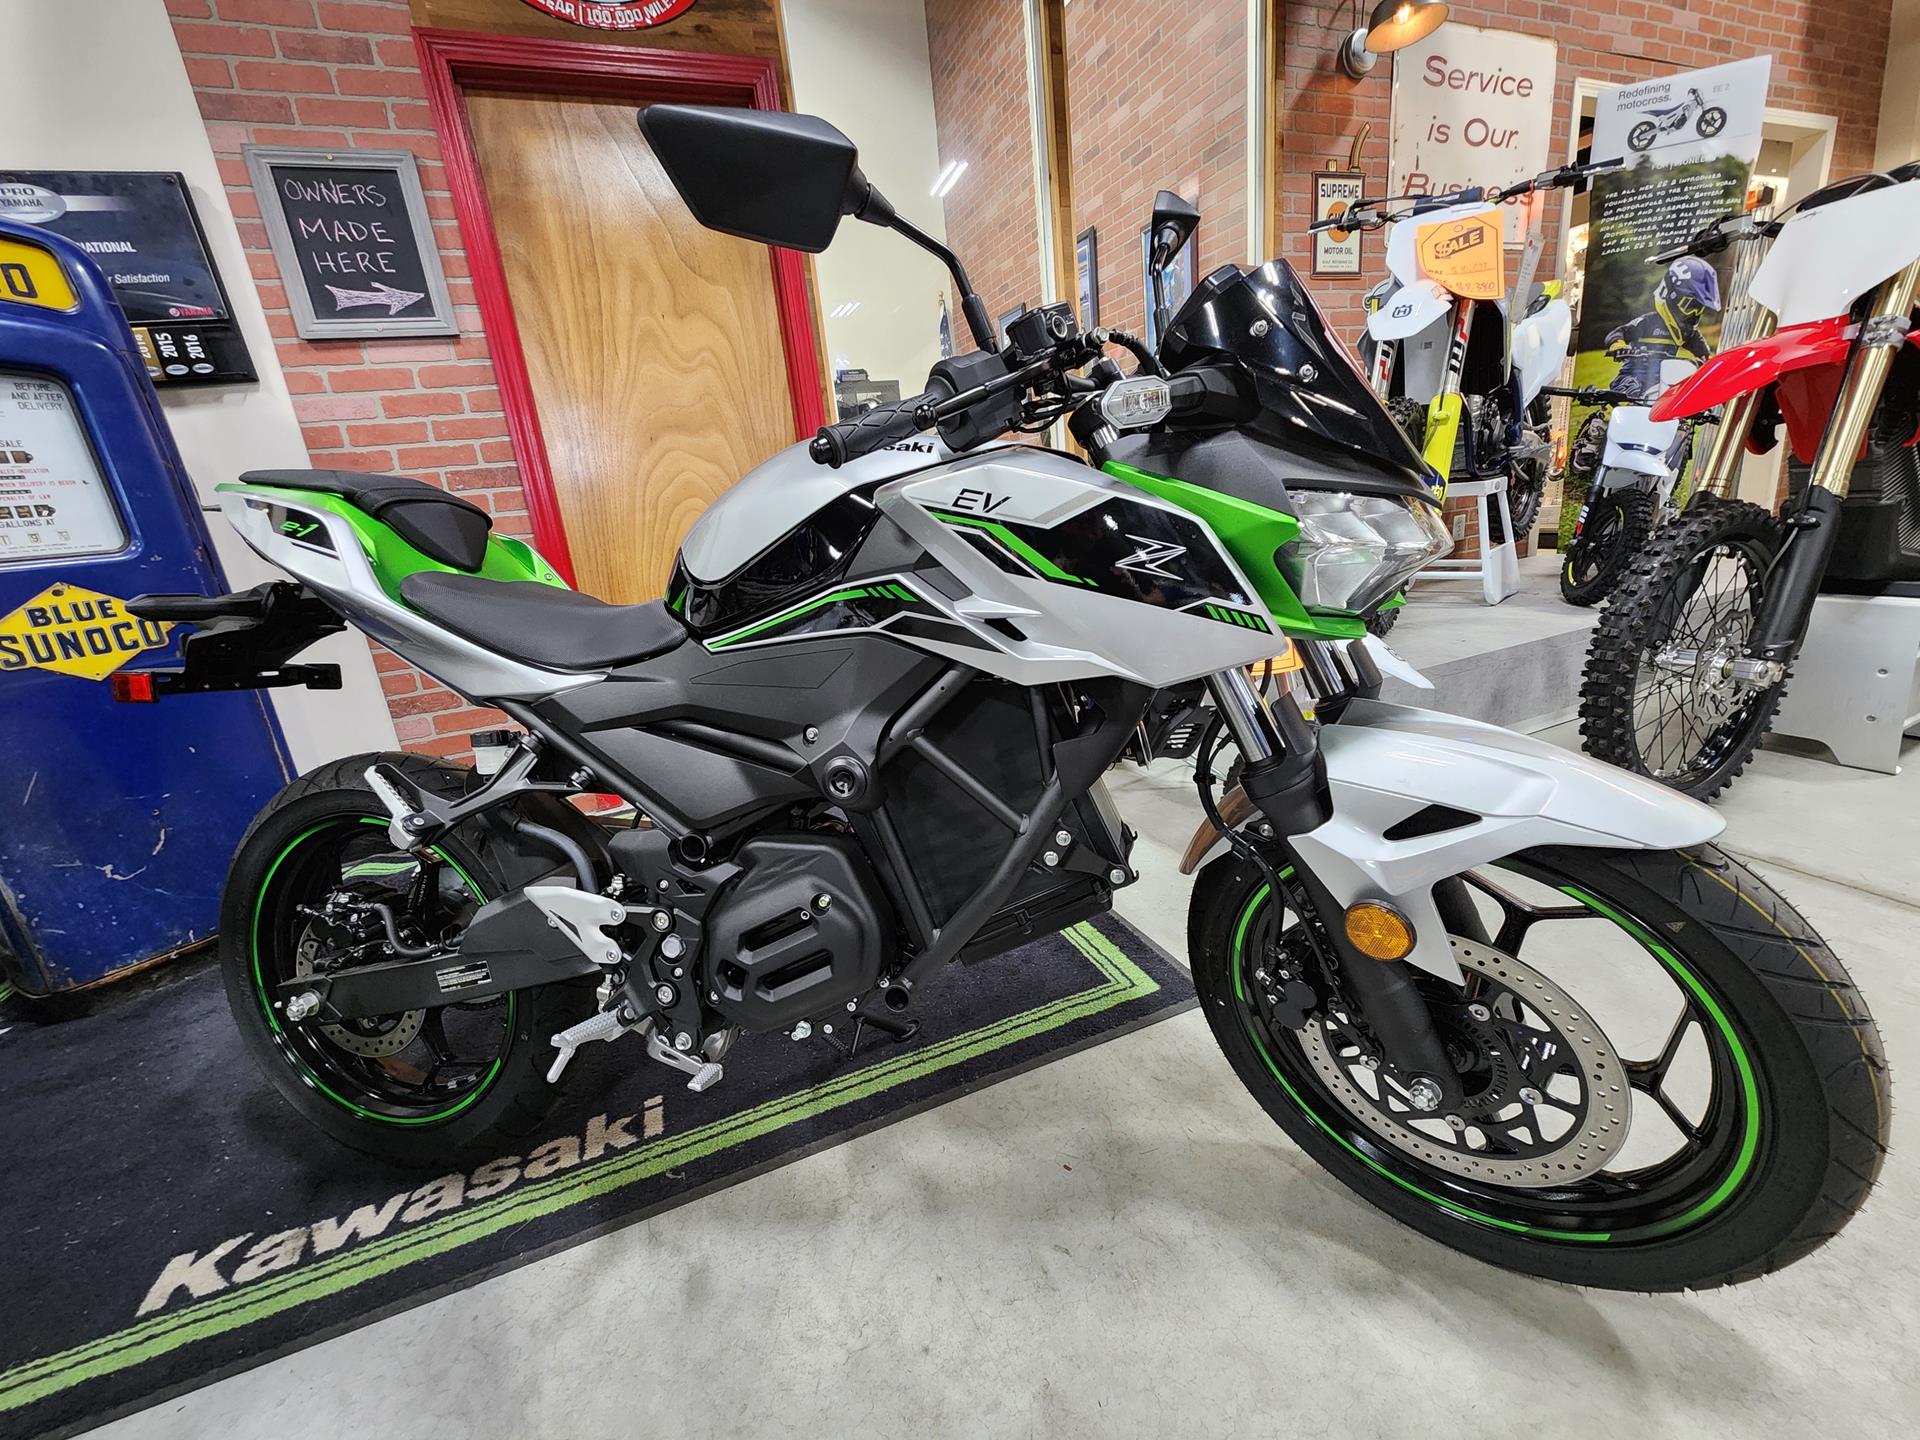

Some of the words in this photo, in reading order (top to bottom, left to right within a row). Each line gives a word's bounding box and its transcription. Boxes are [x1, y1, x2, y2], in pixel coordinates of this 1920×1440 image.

[535, 0, 577, 19] EAR
[1422, 54, 1533, 98] Service
[1618, 83, 1671, 101] Redefining
[1616, 94, 1673, 112] motocross.
[1427, 115, 1451, 144] is
[1, 187, 35, 196] PRO
[284, 178, 387, 207] OWNERS
[1320, 183, 1360, 199] SUPREME
[2, 198, 44, 208] YAMAHA
[298, 217, 395, 243] MADE
[1323, 246, 1343, 255] MOTOR
[1344, 247, 1354, 255] OIL
[312, 250, 396, 274] HERE
[115, 272, 170, 284] Satisfaction
[154, 332, 179, 359] 2015
[182, 333, 206, 360] 2016
[13, 382, 51, 392] BEFORE
[11, 392, 30, 401] AND
[33, 393, 64, 402] AFTER
[17, 401, 63, 411] DELIVERY
[883, 441, 935, 454] saki
[950, 488, 1012, 514] EV
[46, 518, 56, 526] AT
[24, 598, 117, 628] BLUE
[0, 617, 167, 669] SUNOCO
[135, 1094, 664, 1318] Kawasaki
